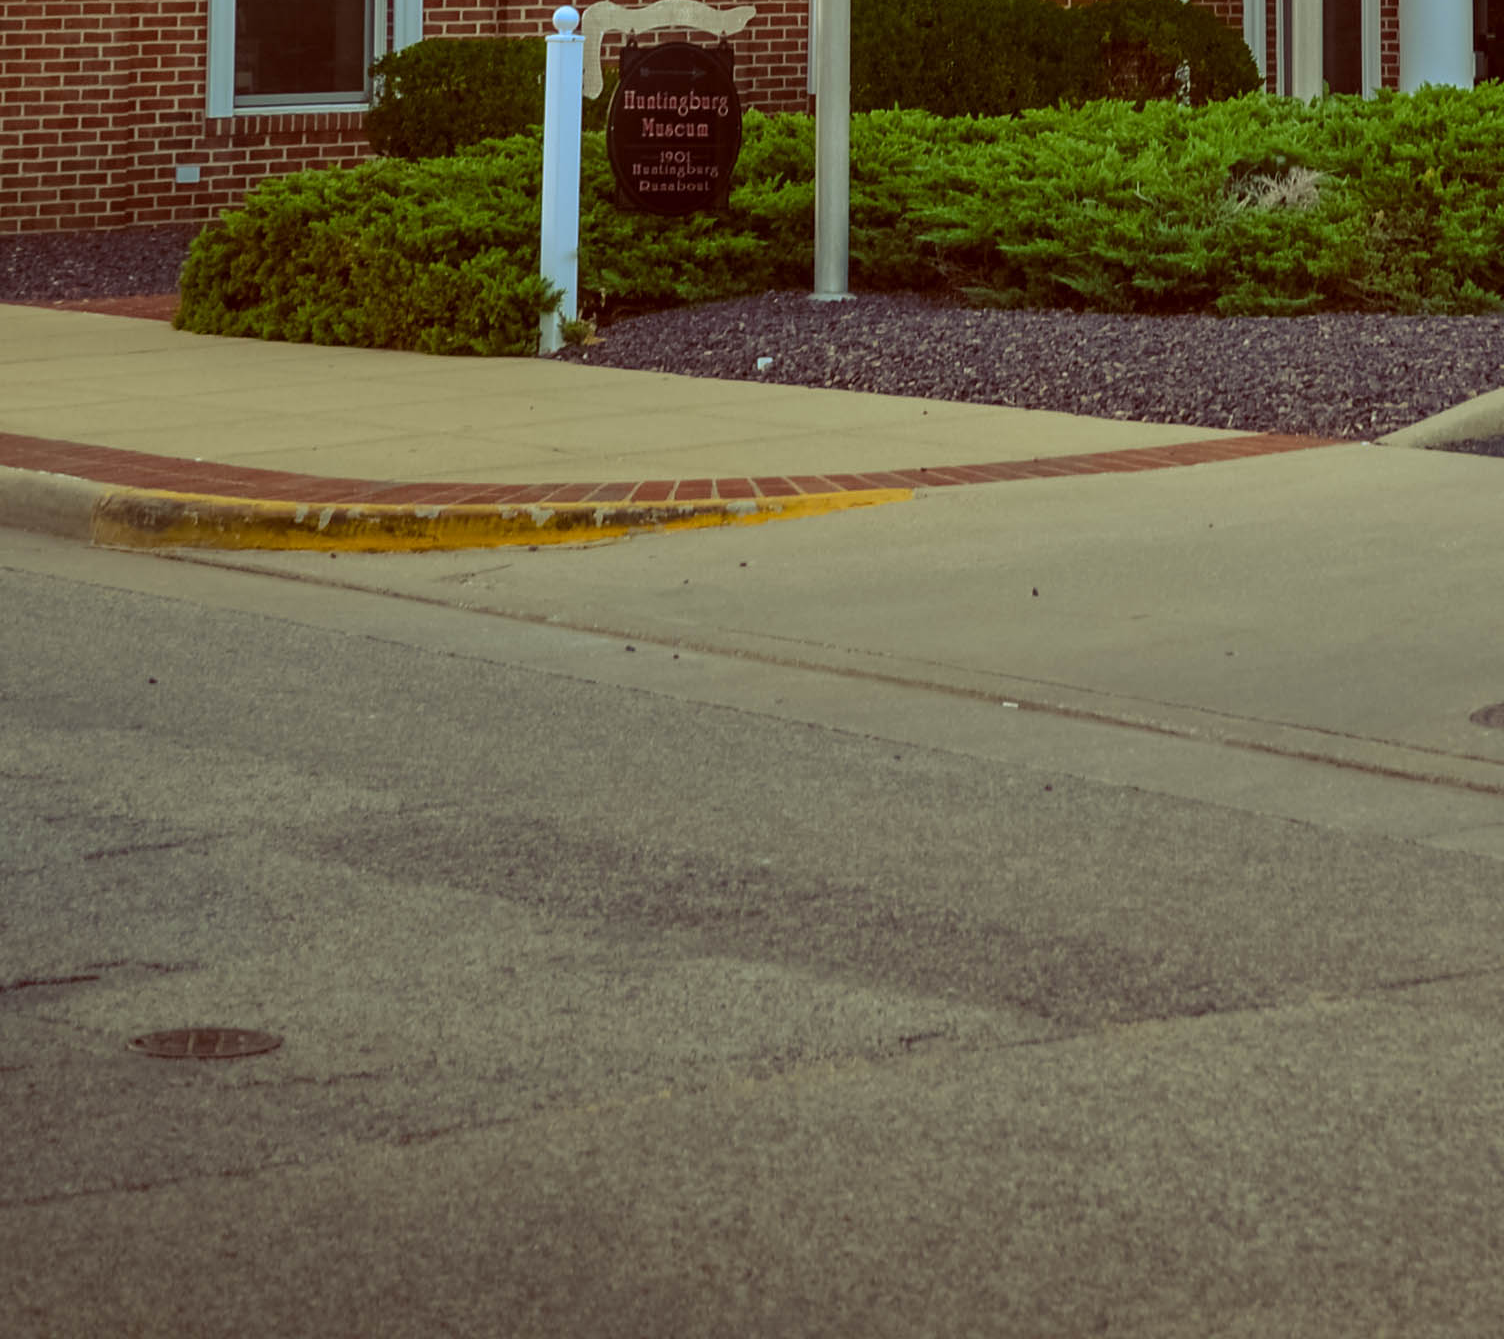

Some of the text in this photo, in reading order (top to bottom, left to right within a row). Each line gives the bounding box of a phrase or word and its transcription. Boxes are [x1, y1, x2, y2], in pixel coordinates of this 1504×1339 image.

[623, 89, 729, 117] Huntingburg
[660, 150, 691, 164] 1901
[632, 163, 719, 179] Huntingburg
